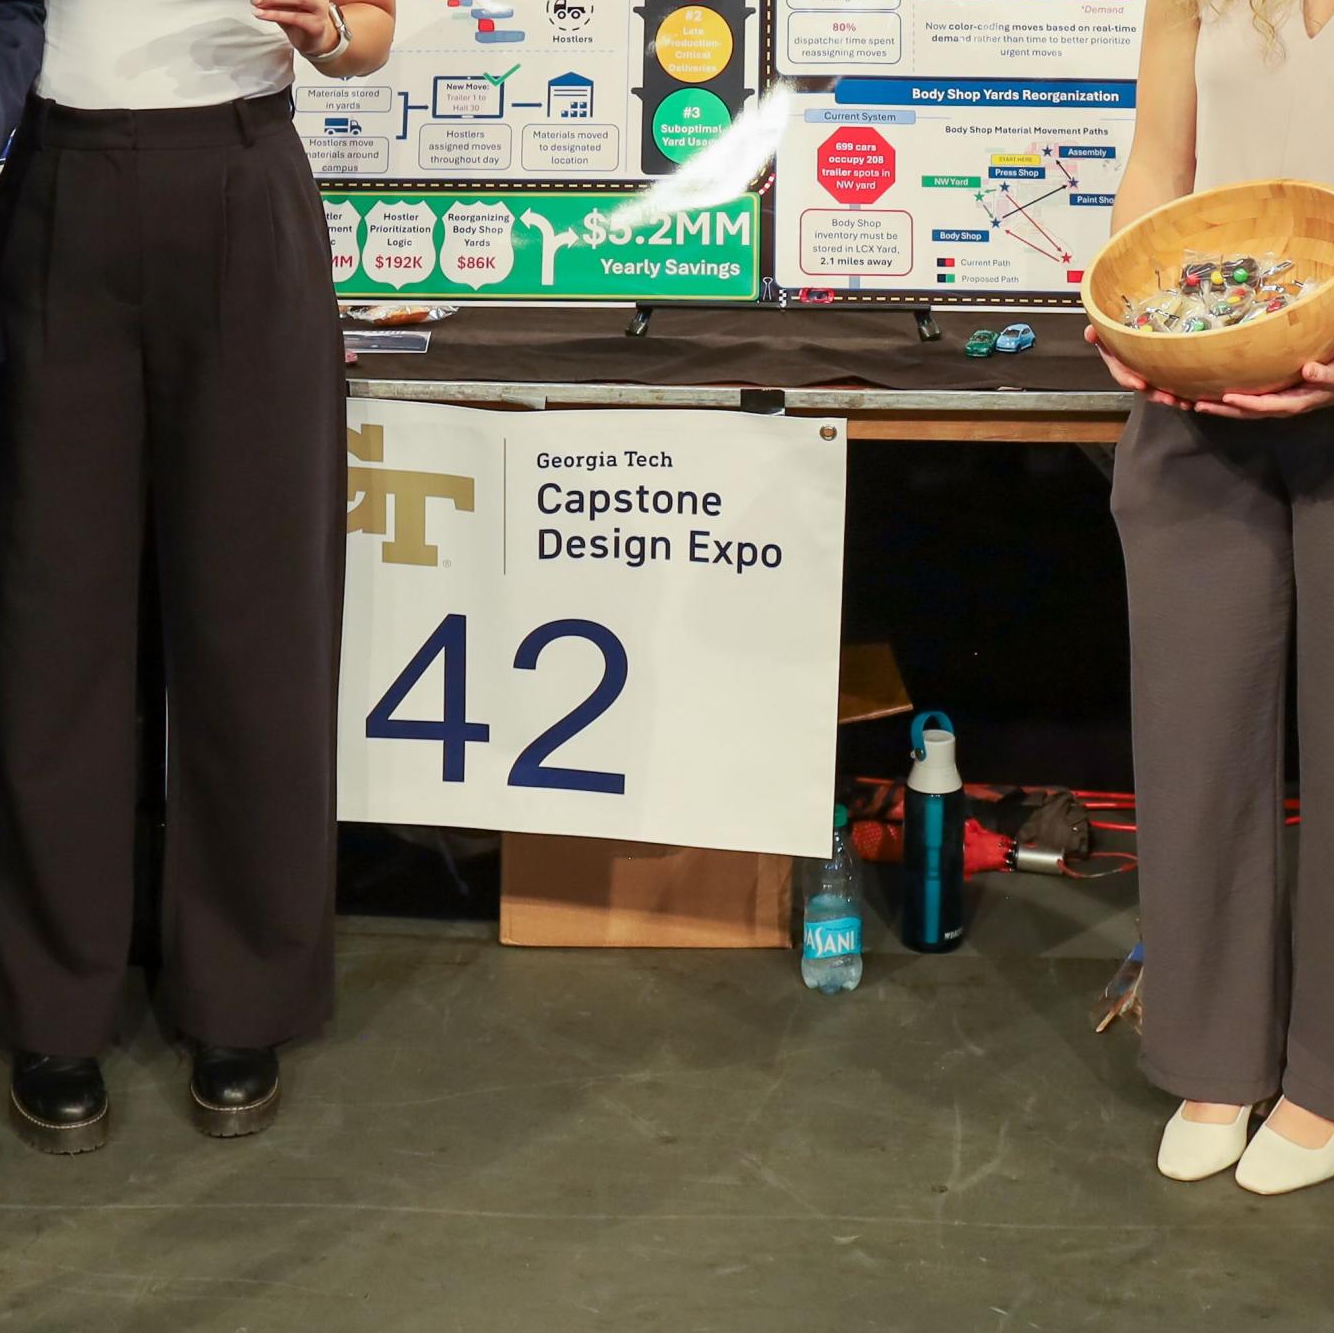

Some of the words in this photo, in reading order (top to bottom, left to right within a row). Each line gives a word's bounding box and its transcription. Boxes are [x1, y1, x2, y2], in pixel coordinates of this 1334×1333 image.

[833, 23, 856, 31] 80%
[553, 34, 593, 43] Hostlers
[913, 88, 944, 100] Body
[947, 89, 980, 102] Shop
[983, 90, 1019, 100] Yards
[1023, 90, 1119, 102] Reorganization
[683, 107, 700, 118] #3
[824, 112, 860, 120] Current
[862, 113, 896, 121] System
[661, 124, 721, 134] Suboptimal
[946, 126, 967, 134] Body
[970, 126, 992, 135] Shop
[995, 127, 1031, 135] Material
[1034, 127, 1080, 135] Movement
[533, 131, 574, 139] Materials
[551, 143, 601, 153] designated
[836, 143, 853, 151] 699
[1068, 148, 1106, 157] Assembly
[551, 157, 588, 165] location
[829, 156, 864, 164] occupy
[867, 156, 883, 164] 208
[822, 168, 851, 176] trailer
[854, 170, 879, 178] spots
[1019, 169, 1039, 178] Shop
[837, 181, 853, 189] NW
[855, 182, 875, 191] yard
[951, 178, 968, 186] Yard
[1077, 196, 1097, 204] Paint
[383, 213, 418, 221] Hostler
[448, 213, 509, 223] Reorganizing
[370, 225, 431, 234] Prioritization
[583, 210, 750, 248] $5.2MM
[940, 232, 959, 240] Body
[961, 232, 981, 240] Shop
[387, 238, 412, 247] Logic
[464, 239, 490, 247] Yards
[375, 255, 422, 269] $192K
[458, 256, 495, 269] $86K
[821, 257, 834, 265] 2.1
[838, 257, 864, 266] miles
[868, 259, 892, 267] away
[600, 258, 662, 281] Yearly
[667, 259, 740, 278] Savings
[537, 452, 617, 470] Georgia
[625, 450, 673, 468] Tech
[537, 483, 722, 520] Capstone
[538, 528, 670, 566] Design
[689, 530, 783, 573] Expo
[366, 614, 628, 795] 42
